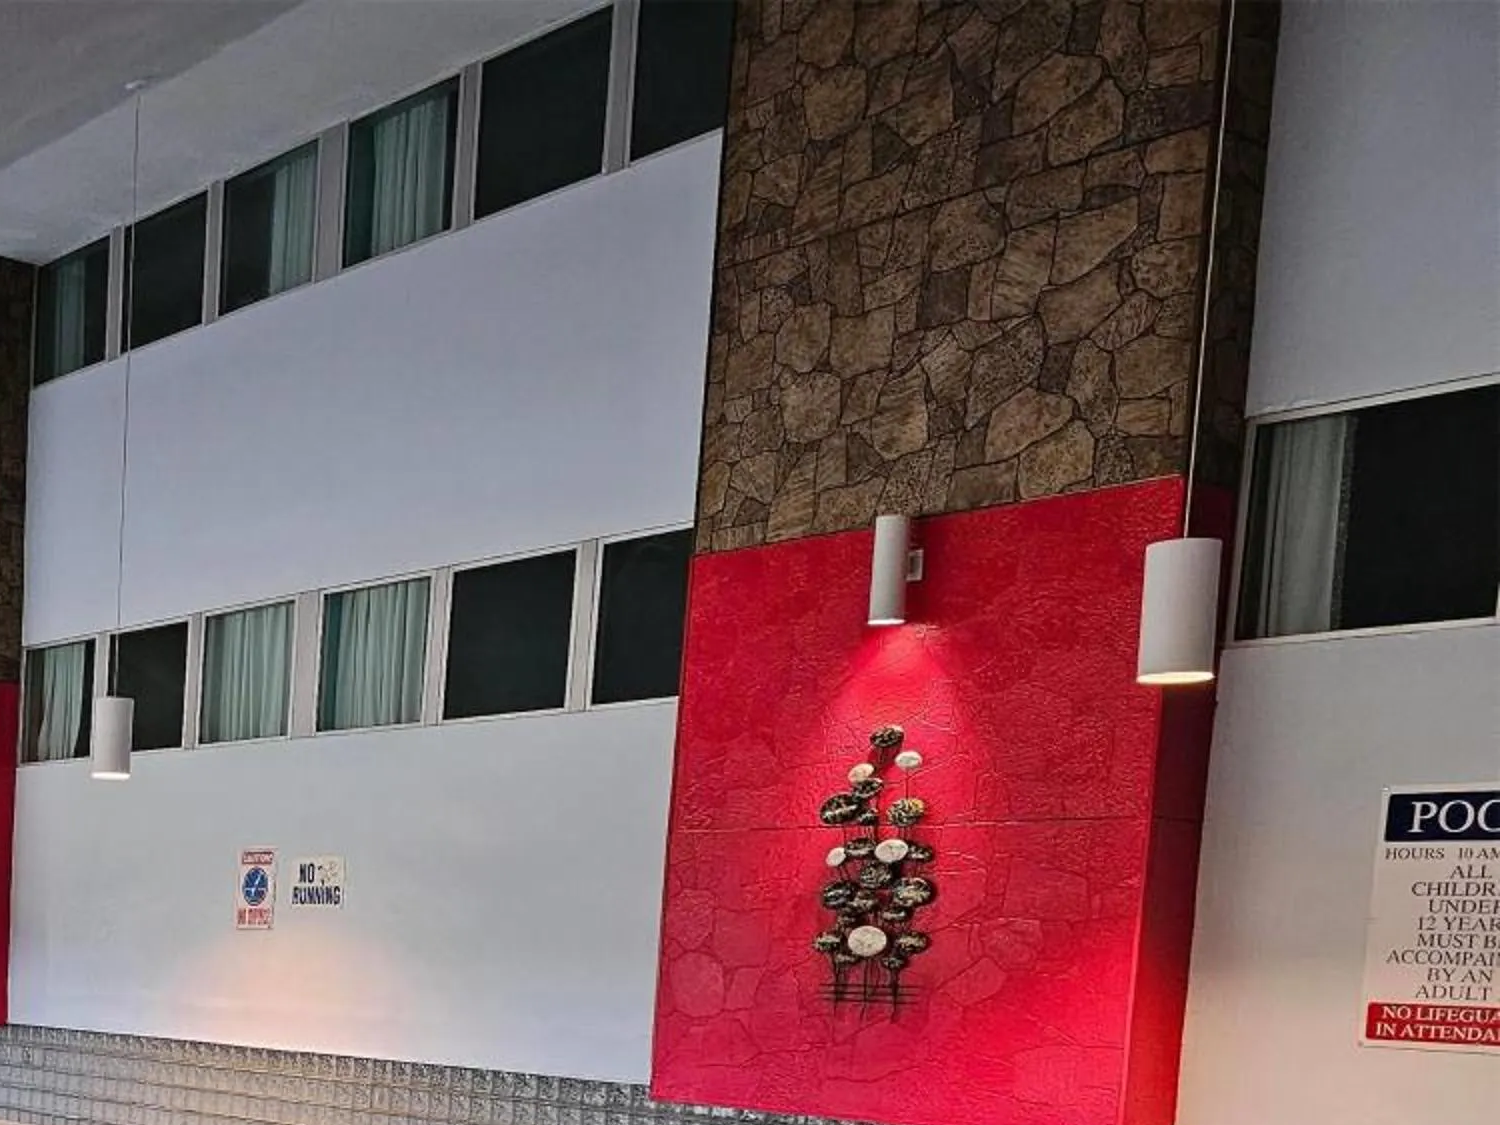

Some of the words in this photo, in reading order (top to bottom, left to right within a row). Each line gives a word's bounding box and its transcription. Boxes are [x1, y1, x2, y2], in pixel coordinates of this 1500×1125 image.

[1385, 847, 1445, 860] HOURS
[1458, 847, 1474, 859] 10
[299, 863, 315, 883] NO
[1450, 864, 1493, 879] ALL
[291, 885, 341, 905] RUNNING
[1411, 881, 1500, 897] CHILDR
[1418, 916, 1437, 931] 12
[1417, 933, 1480, 949] MUST
[1484, 934, 1500, 949] B
[1428, 967, 1456, 982] BY
[1461, 969, 1493, 983] AN
[1415, 984, 1493, 1001] ADULT
[1382, 1005, 1412, 1020] NO
[1376, 1022, 1397, 1037] IN
[1400, 1023, 1500, 1042] ATTENDA
